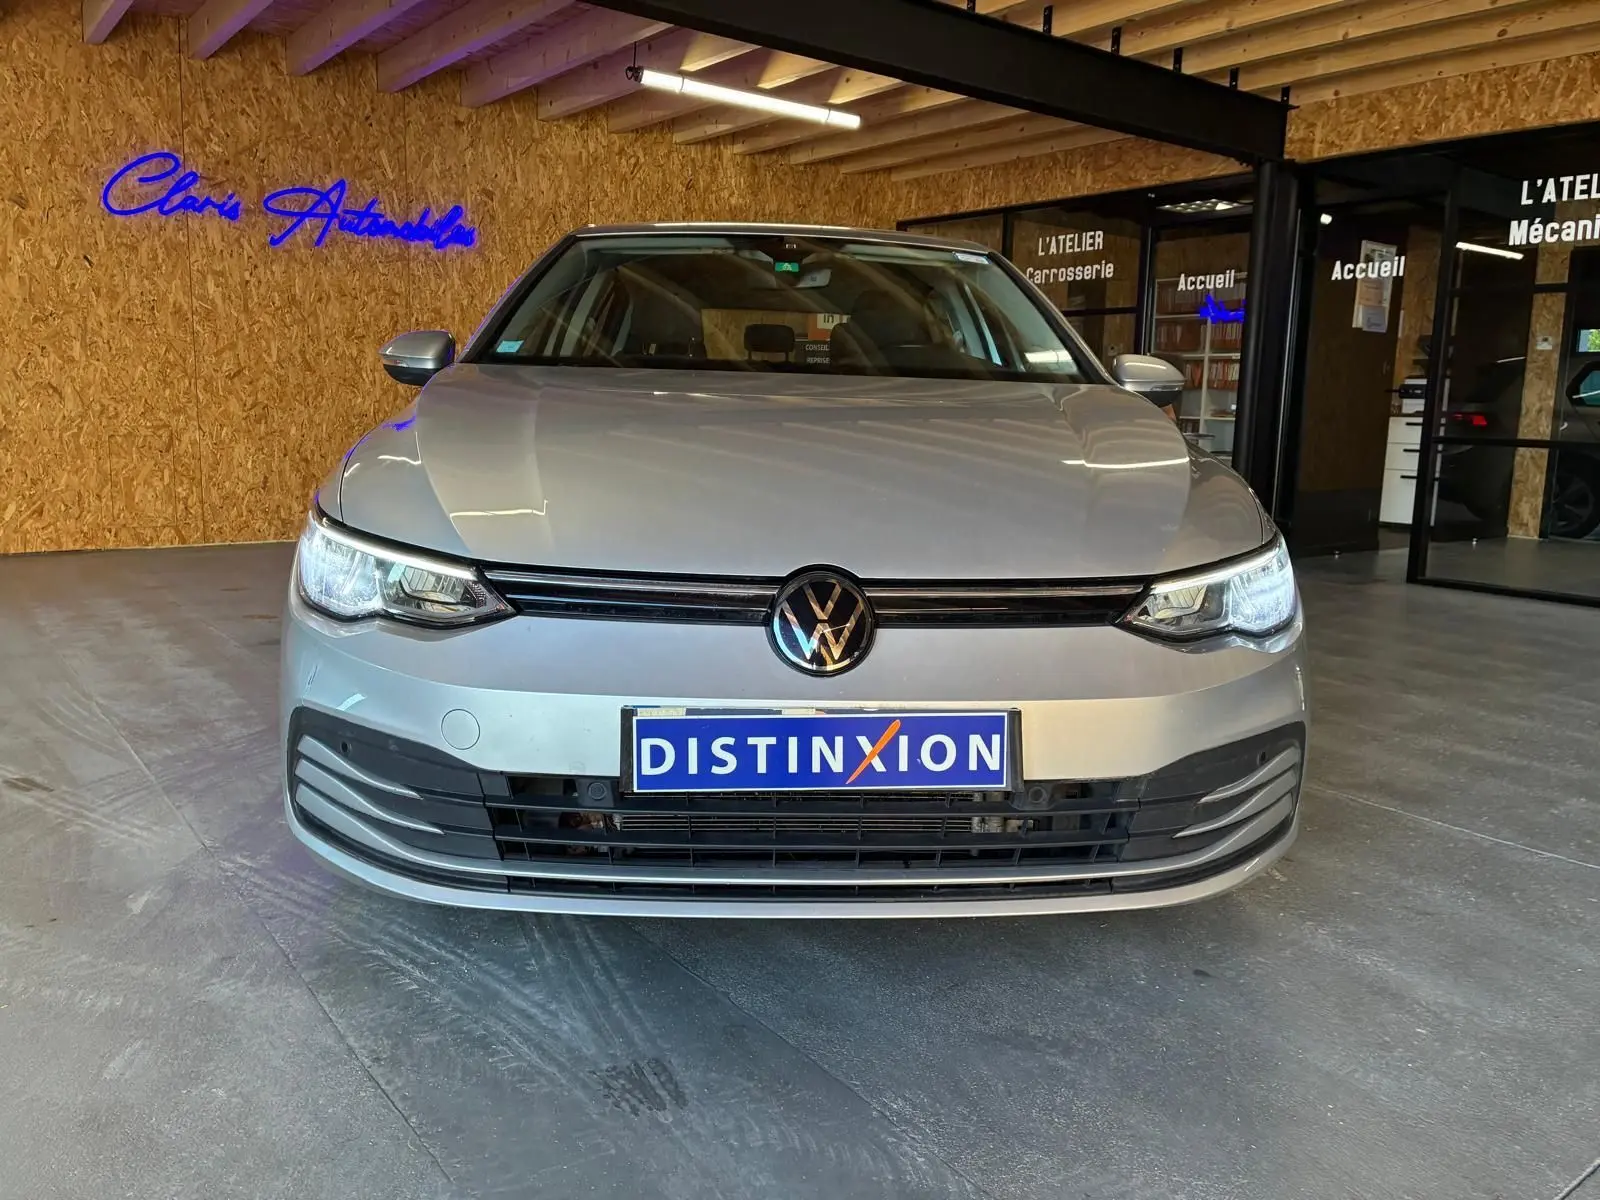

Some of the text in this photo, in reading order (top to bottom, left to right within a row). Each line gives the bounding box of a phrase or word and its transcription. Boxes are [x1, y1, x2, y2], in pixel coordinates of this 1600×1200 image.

[1520, 172, 1600, 206] L'ATEL
[1037, 230, 1104, 257] L'ATELIER
[1026, 260, 1114, 285] Carrosserie
[1177, 269, 1235, 292] Accueil
[1331, 255, 1405, 281] Accueil
[640, 719, 1001, 785] DISTINXION
